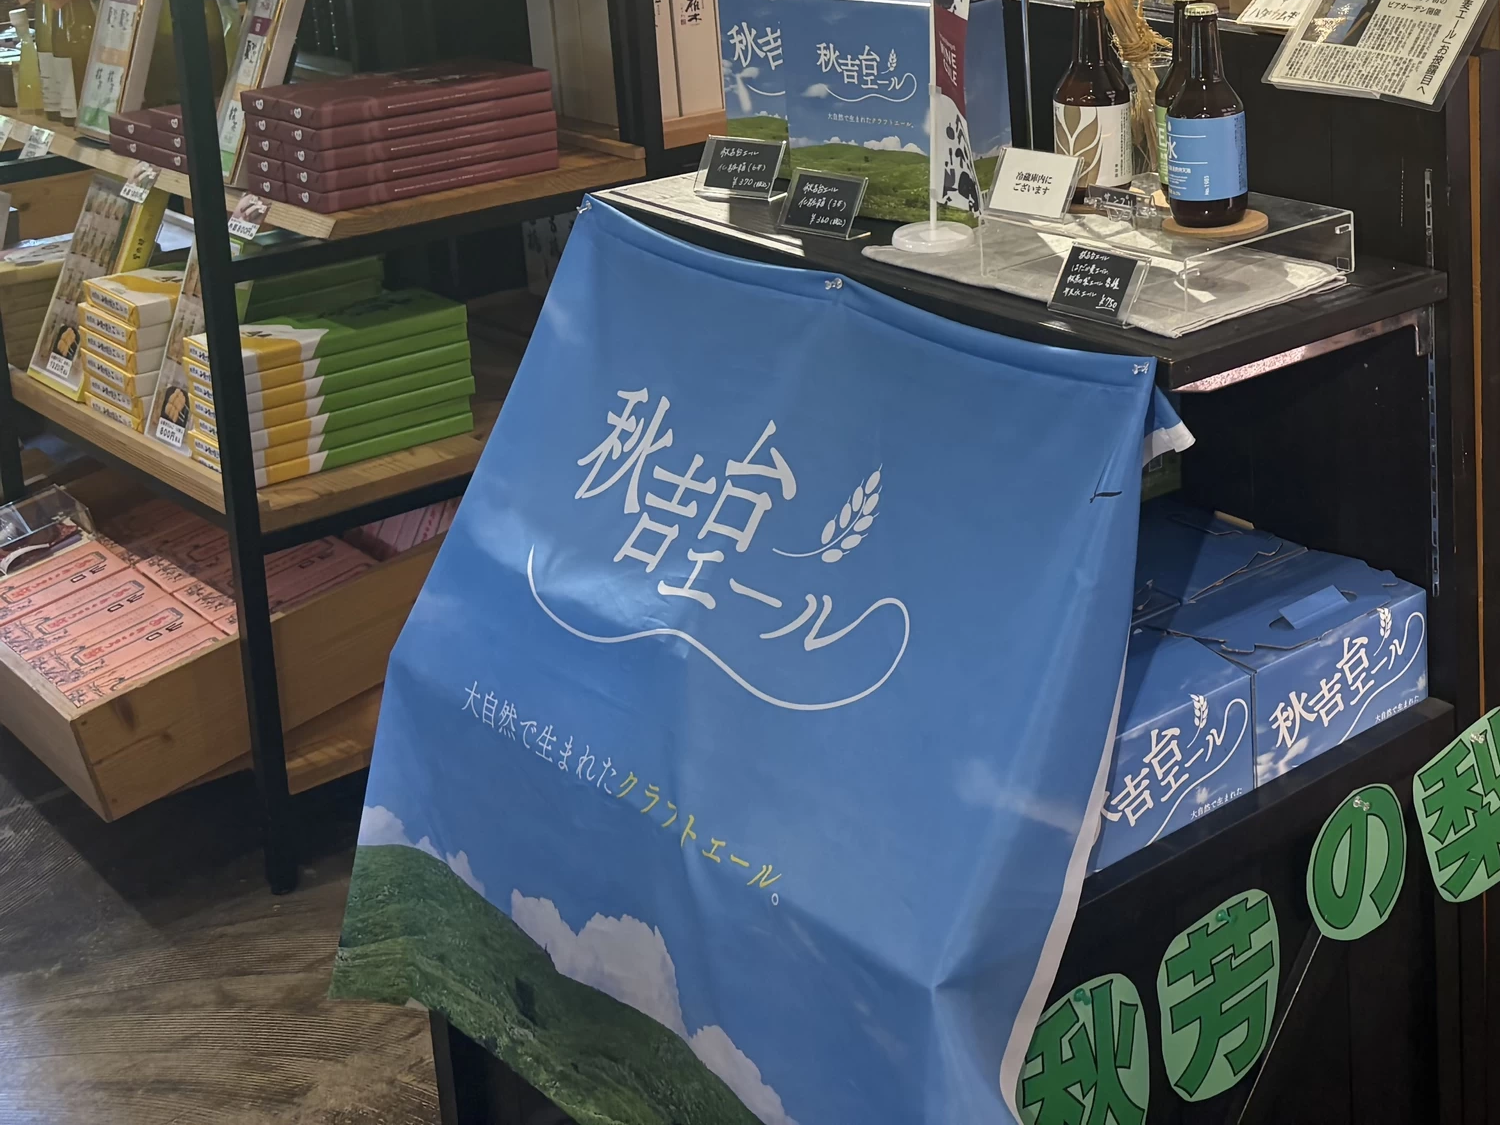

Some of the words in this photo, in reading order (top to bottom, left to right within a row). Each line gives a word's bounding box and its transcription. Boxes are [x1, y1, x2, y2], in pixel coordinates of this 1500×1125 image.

[1249, 7, 1300, 21] ハダカムギ
[1387, 1, 1442, 17] ビアガーデン開催
[816, 42, 905, 92] 秋吉台エール
[827, 112, 915, 129] 大自然で生まれたクラフトエール。
[1012, 182, 1050, 196] ございます
[1015, 171, 1053, 185] 冷蔵庫内に
[574, 386, 838, 651] 秋吉台エール
[1268, 629, 1408, 750] 秋吉台エール
[1374, 694, 1421, 725] 大自然で生まれた
[461, 679, 783, 907] 大自然で生まれたクラフトエール。
[1189, 786, 1244, 821] 大自然で生まれた
